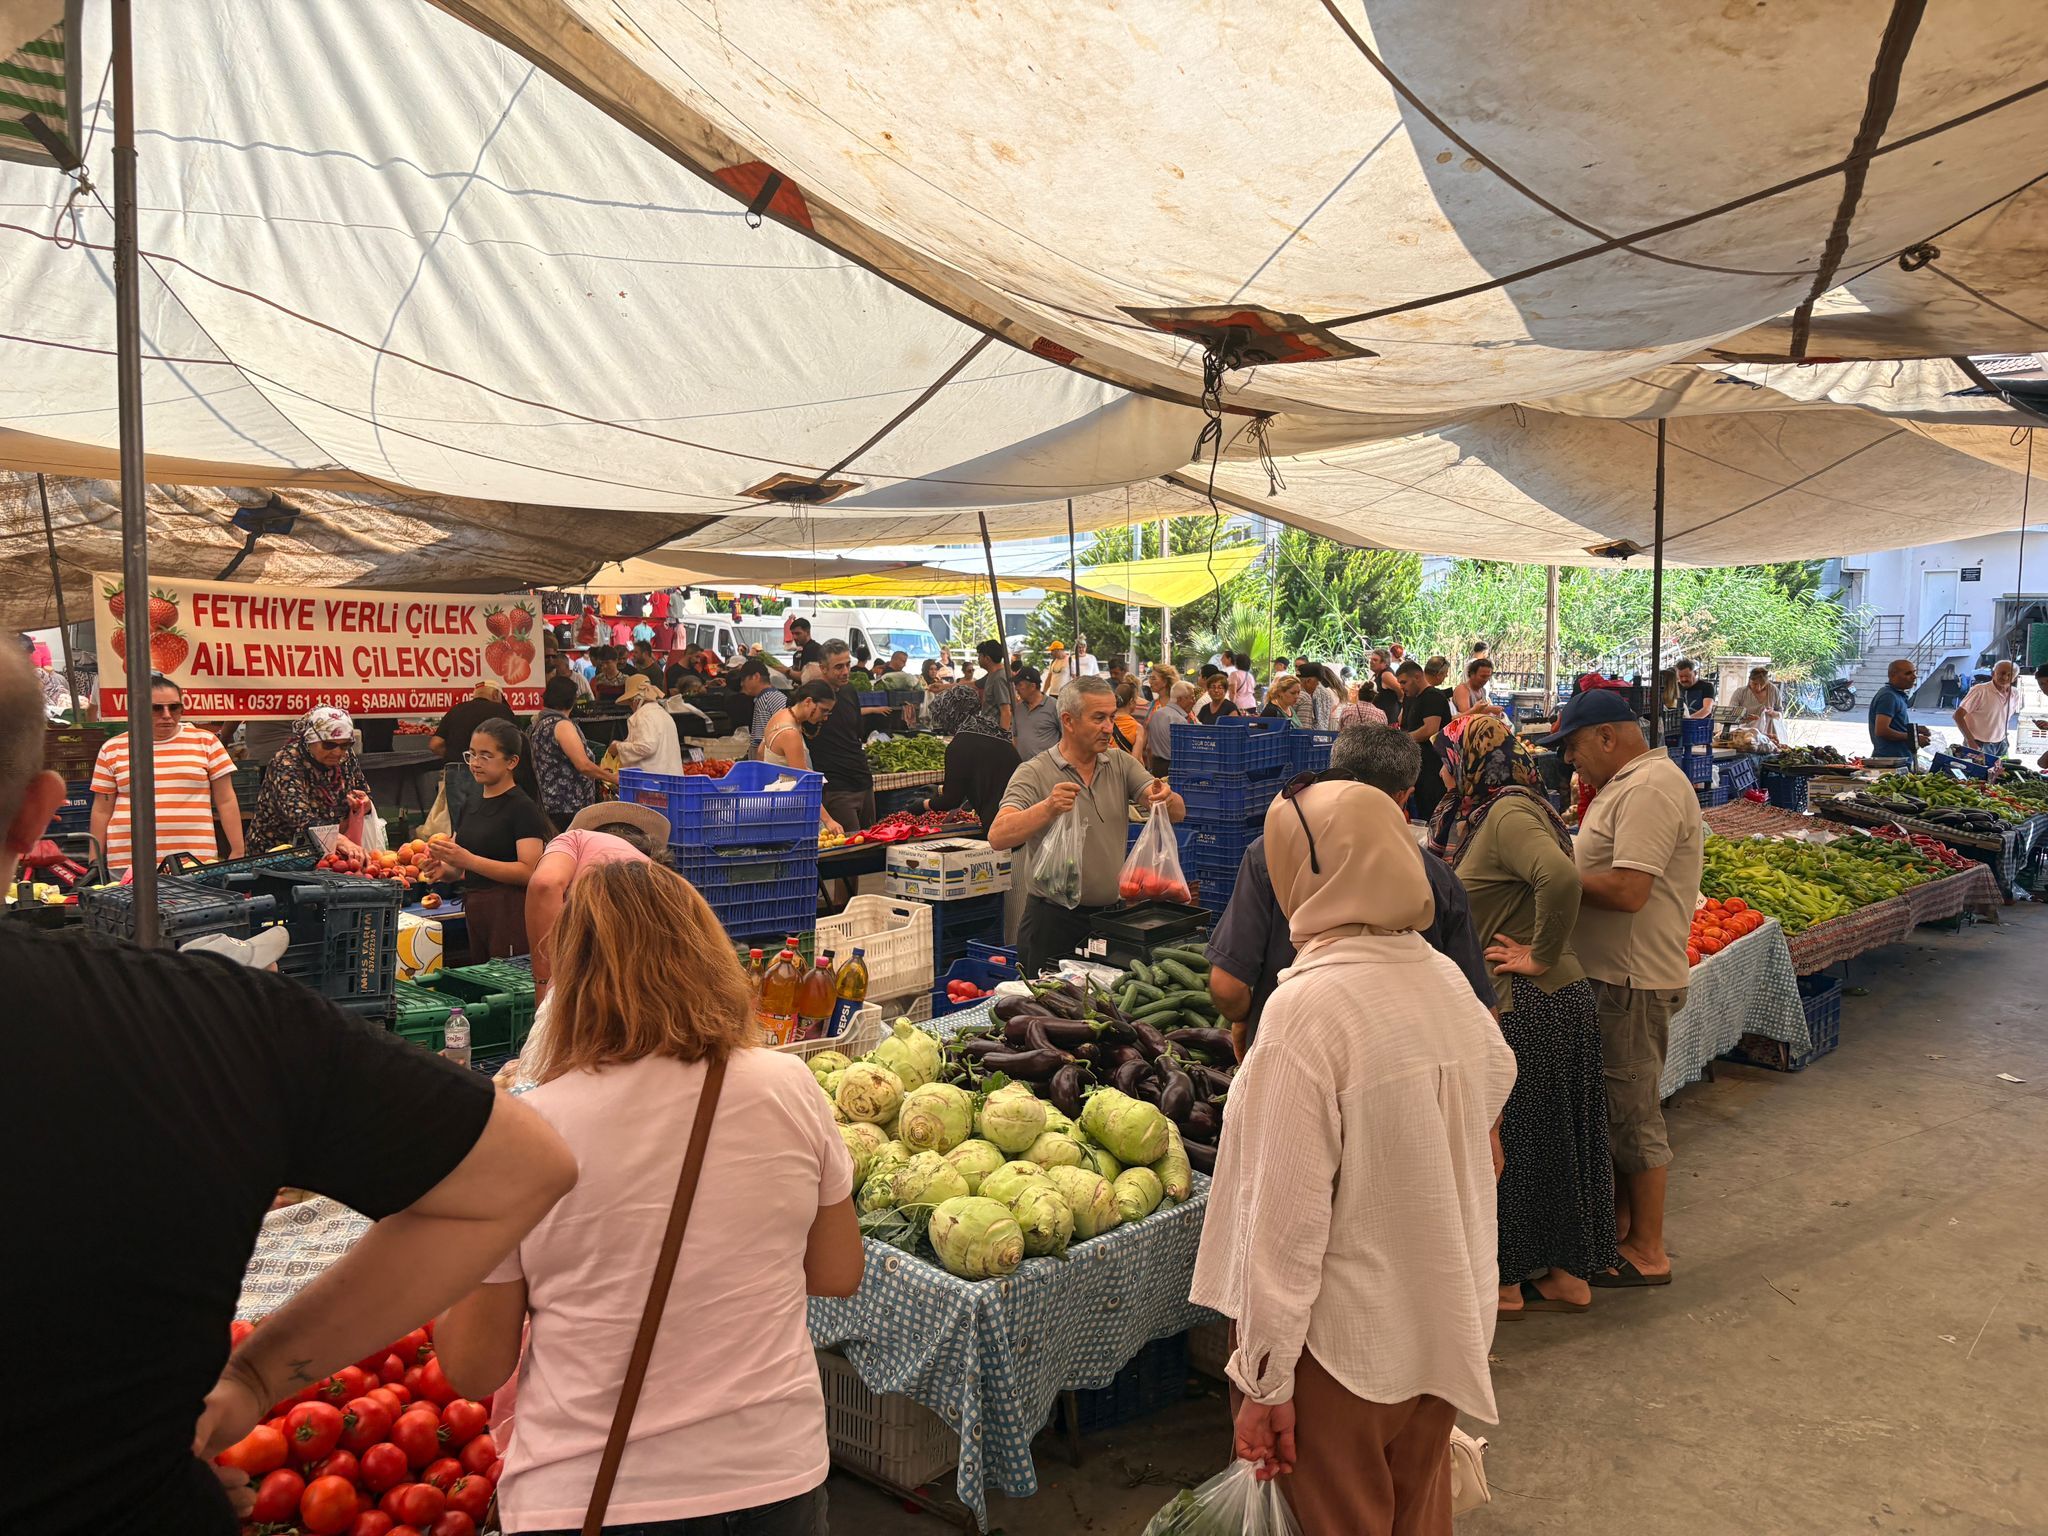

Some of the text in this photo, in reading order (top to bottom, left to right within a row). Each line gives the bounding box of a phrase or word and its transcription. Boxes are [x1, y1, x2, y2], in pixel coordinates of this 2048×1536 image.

[182, 690, 235, 711] ÖZMEN
[247, 694, 280, 710] 0537
[282, 694, 311, 710] 561
[334, 694, 350, 710] 89
[361, 693, 407, 713] ŞABAN
[409, 689, 452, 708] ÖZMEN
[511, 692, 526, 706] 23
[528, 692, 540, 706] 13
[836, 1004, 851, 1036] PEPSI
